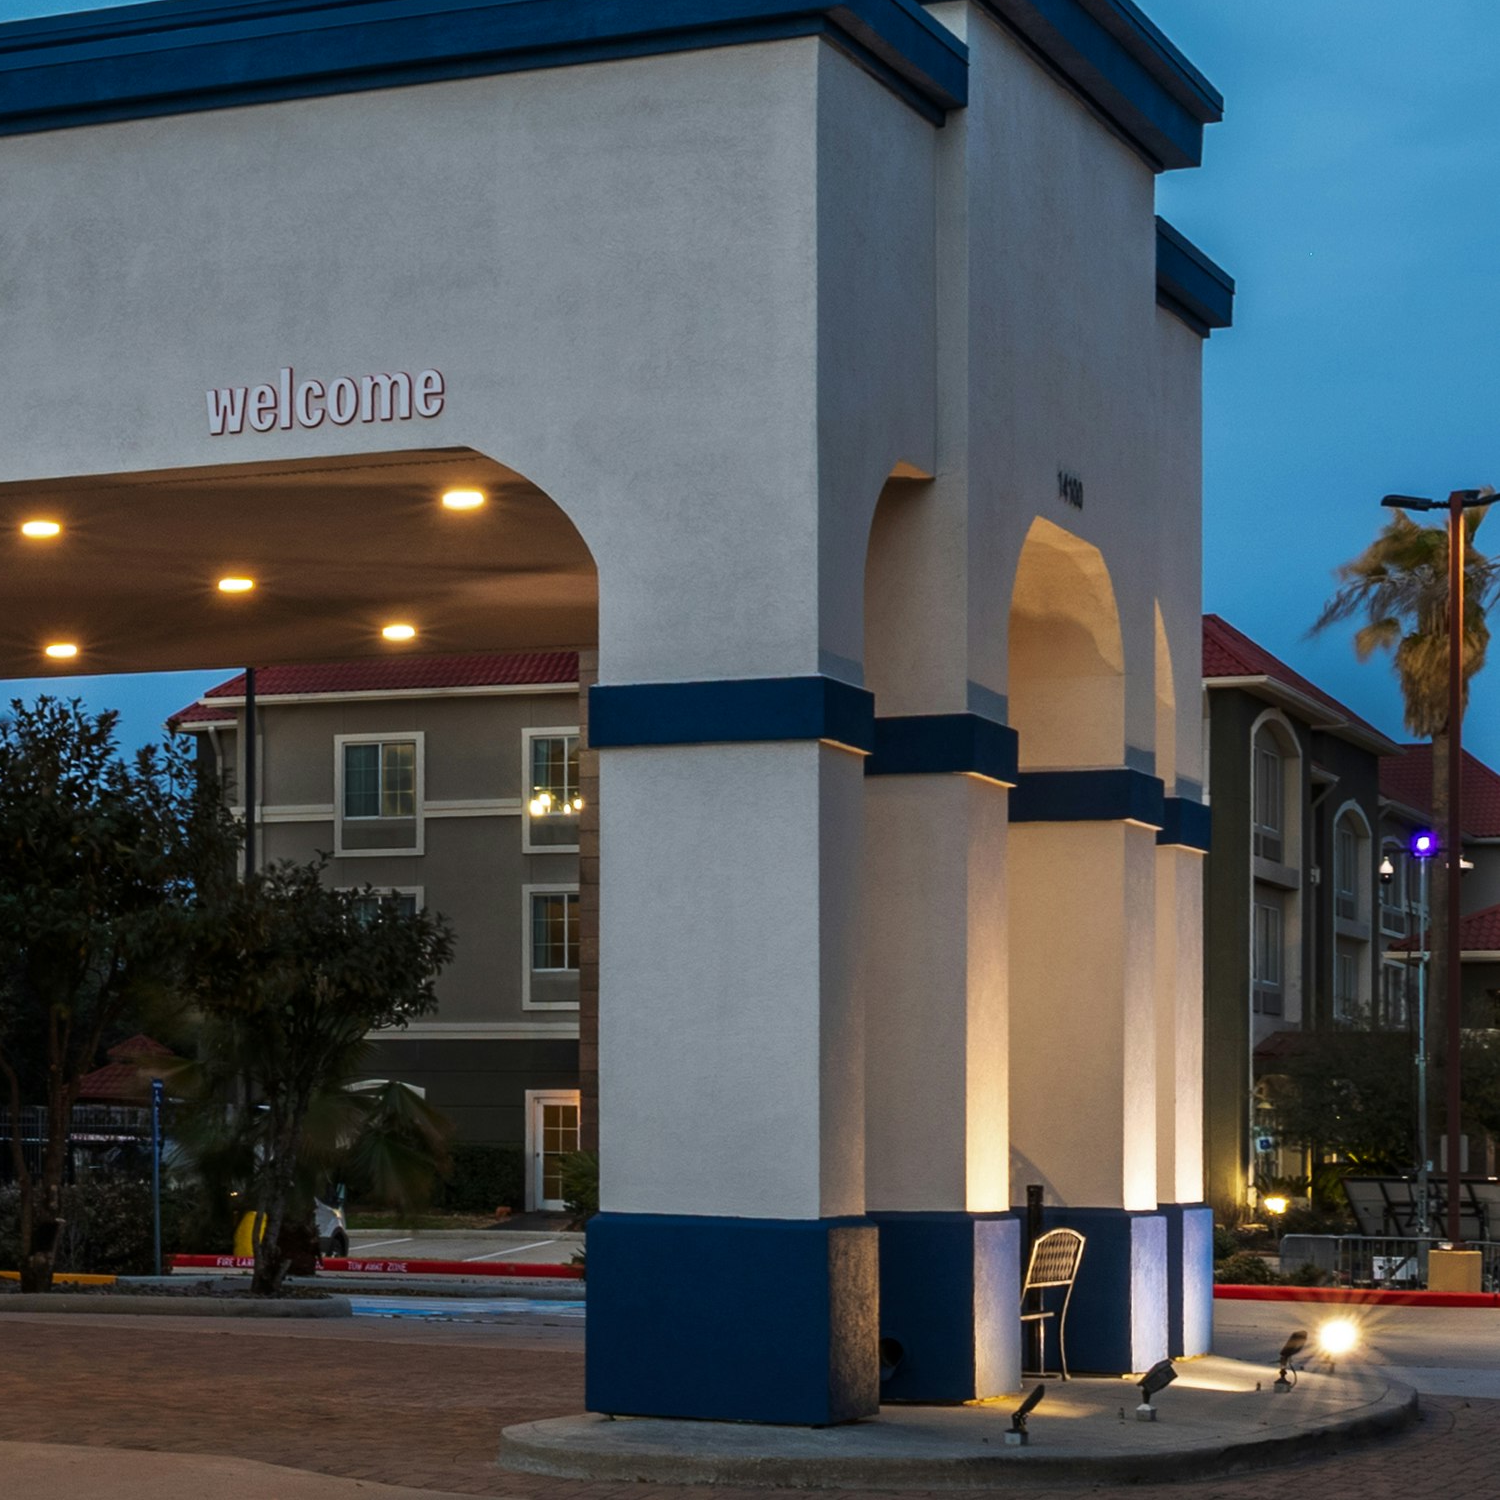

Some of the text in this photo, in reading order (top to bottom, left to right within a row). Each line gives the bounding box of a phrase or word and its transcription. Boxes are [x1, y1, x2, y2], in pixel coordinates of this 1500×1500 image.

[206, 366, 446, 436] welcome
[216, 1256, 234, 1267] FIRE
[387, 1261, 408, 1273] ZONE
